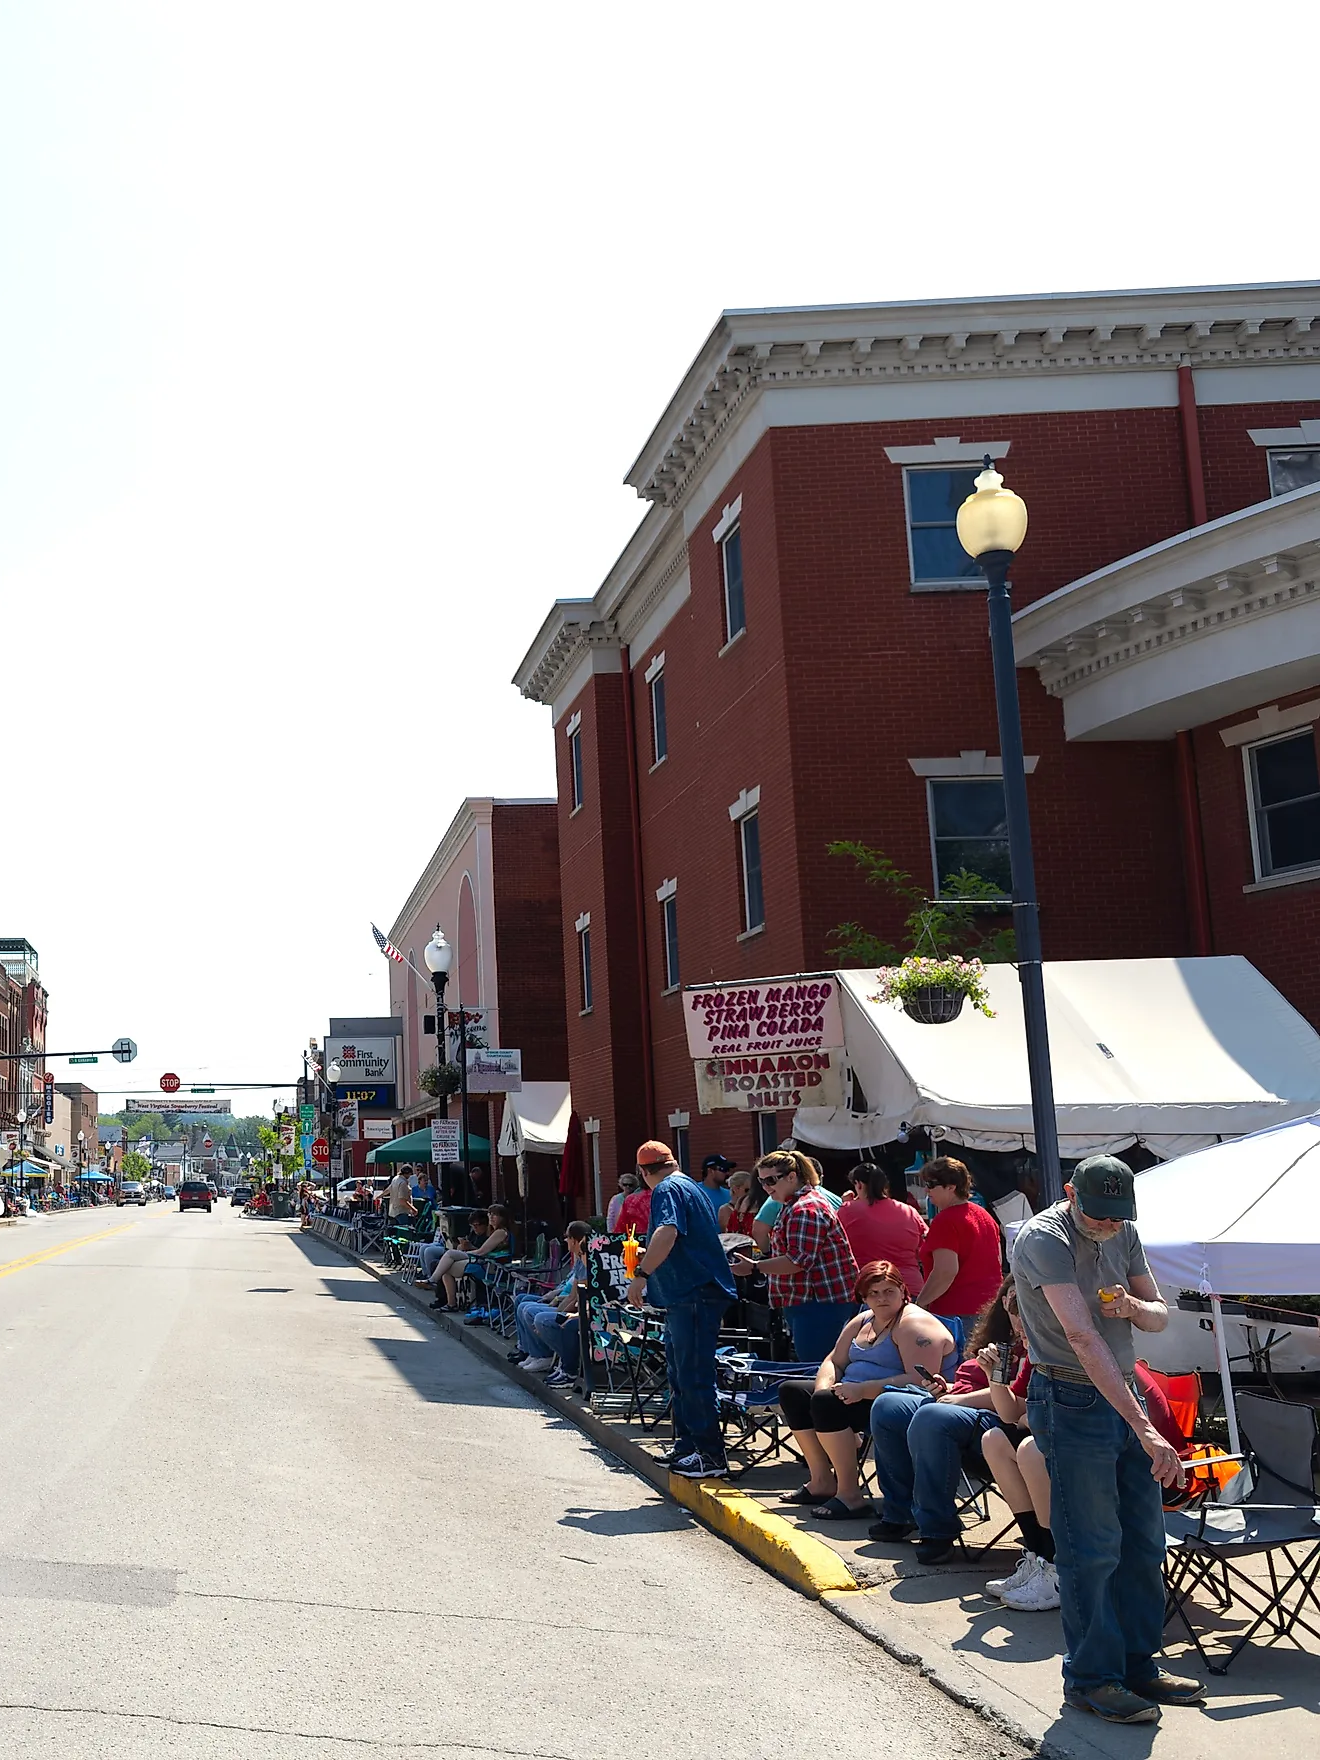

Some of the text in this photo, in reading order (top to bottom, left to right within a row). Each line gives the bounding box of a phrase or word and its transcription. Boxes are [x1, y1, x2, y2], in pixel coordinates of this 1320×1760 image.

[691, 983, 832, 1011] FROZEN MANGO
[703, 1000, 826, 1026] STRAWBERRY
[707, 1016, 824, 1042] PINA COLADA
[357, 1050, 373, 1058] First
[712, 1036, 823, 1054] REAL FRUIT JUICE
[332, 1057, 389, 1070] Community
[365, 1068, 384, 1077] Bank
[706, 1053, 830, 1077] CINNAMON
[723, 1072, 822, 1093] ROASTED
[346, 1091, 376, 1100] 11:07
[746, 1090, 802, 1108] NUTS
[312, 1146, 329, 1155] STO
[1104, 1181, 1122, 1196] M
